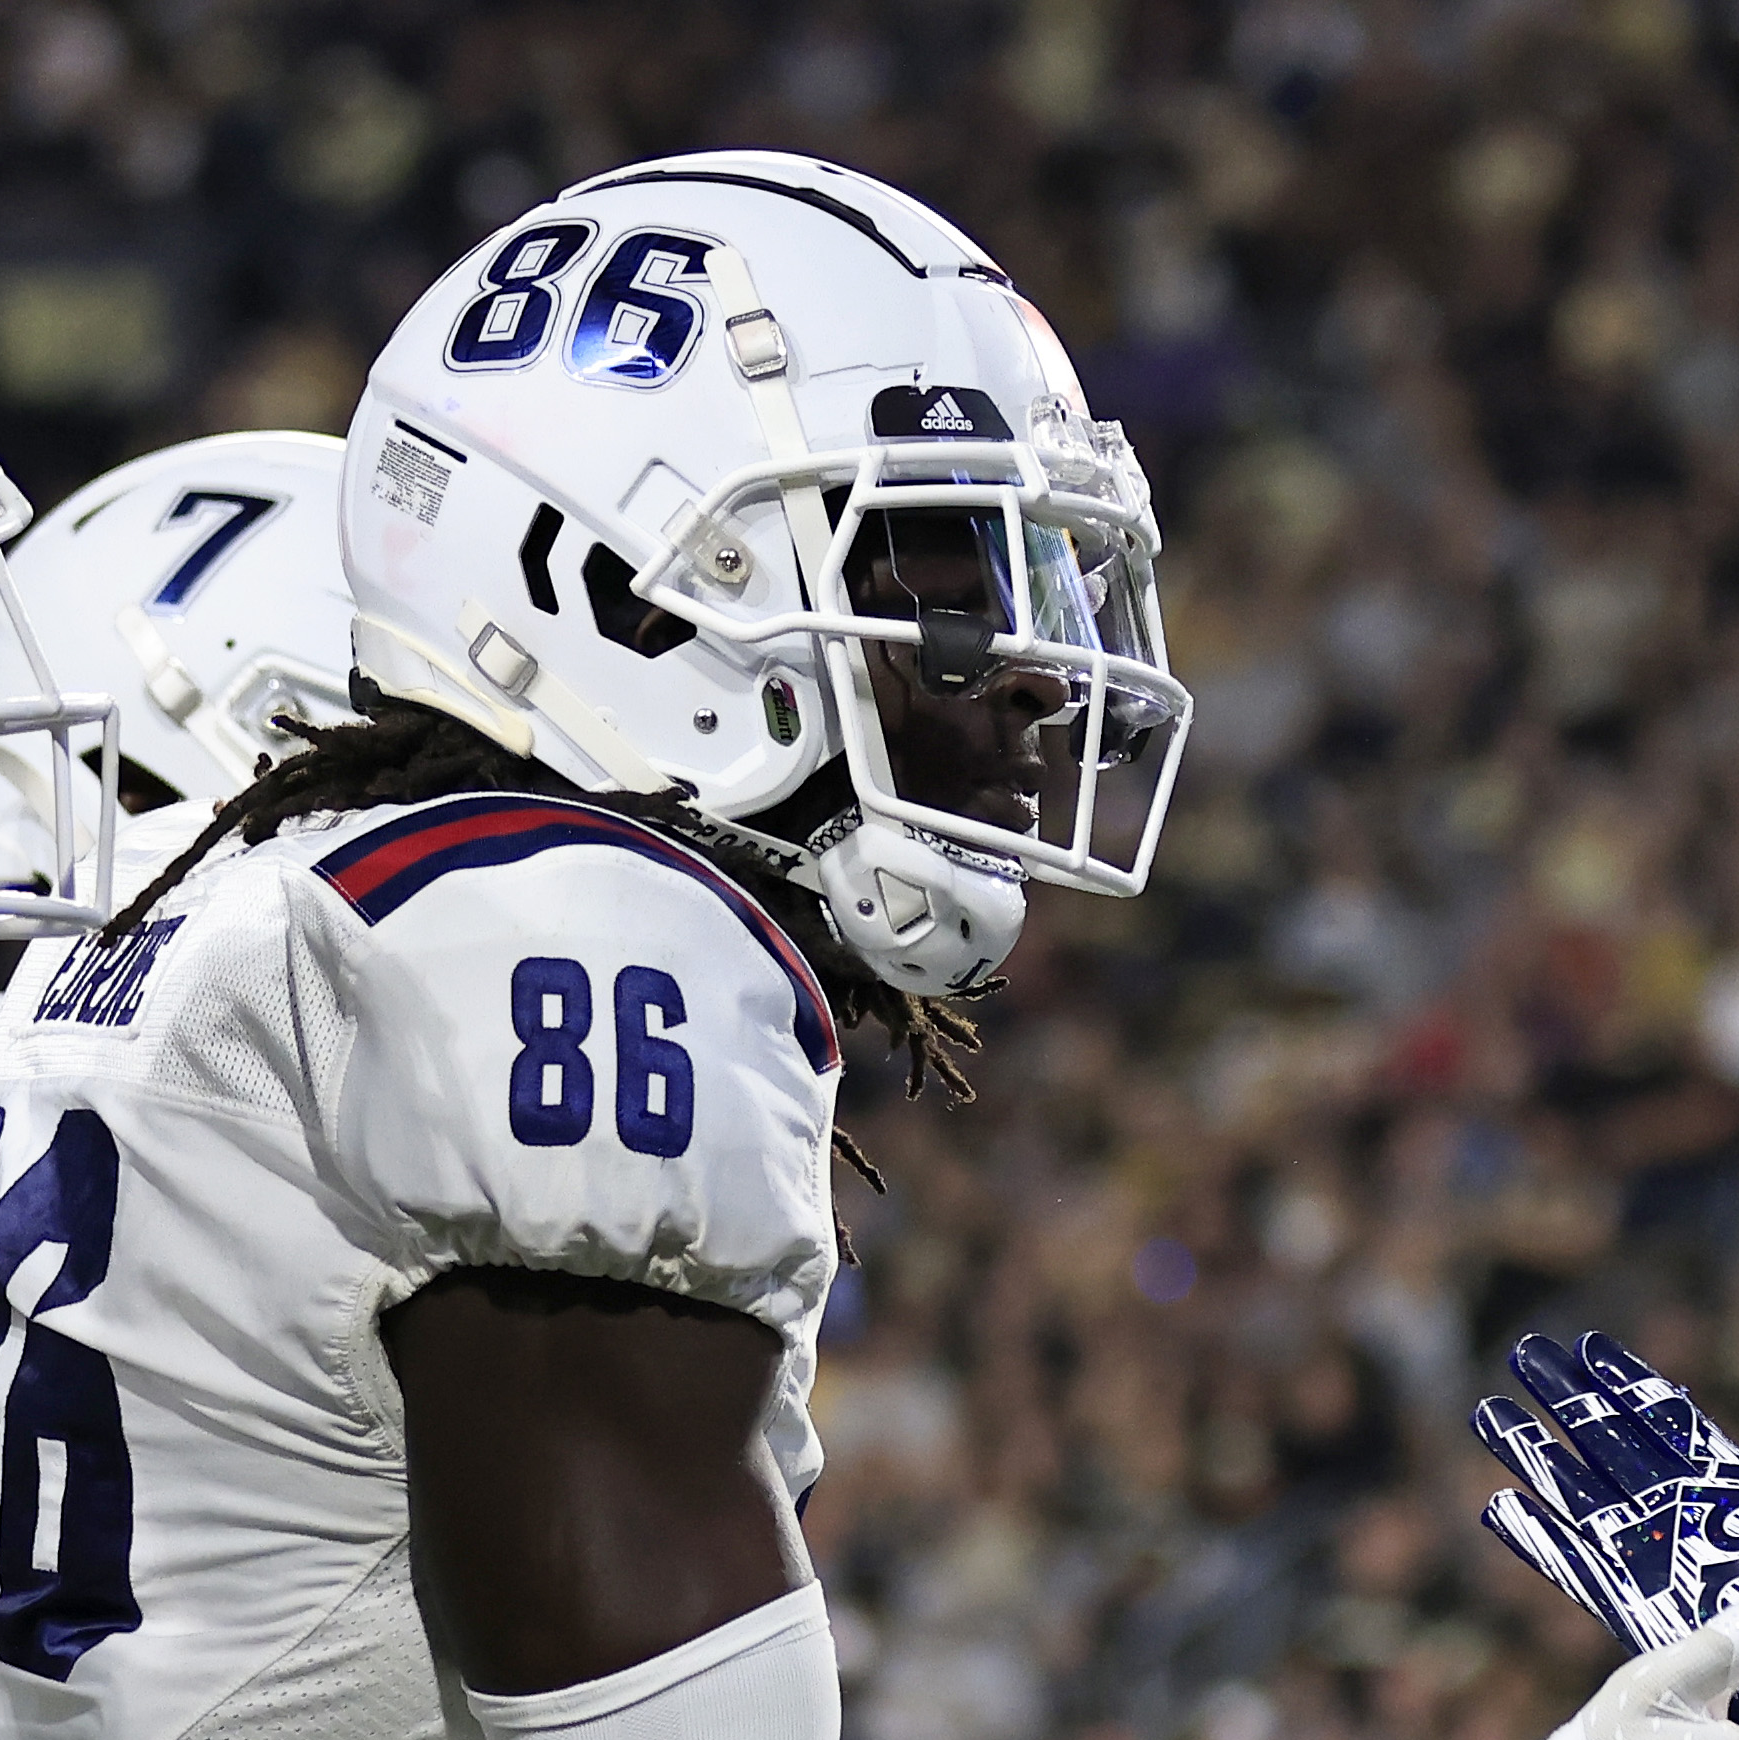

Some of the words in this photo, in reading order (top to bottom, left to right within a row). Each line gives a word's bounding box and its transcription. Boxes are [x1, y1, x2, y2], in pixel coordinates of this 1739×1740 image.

[443, 219, 726, 389] 86
[921, 416, 974, 431] adidas
[145, 488, 290, 615] 7
[510, 956, 695, 1160] 86
